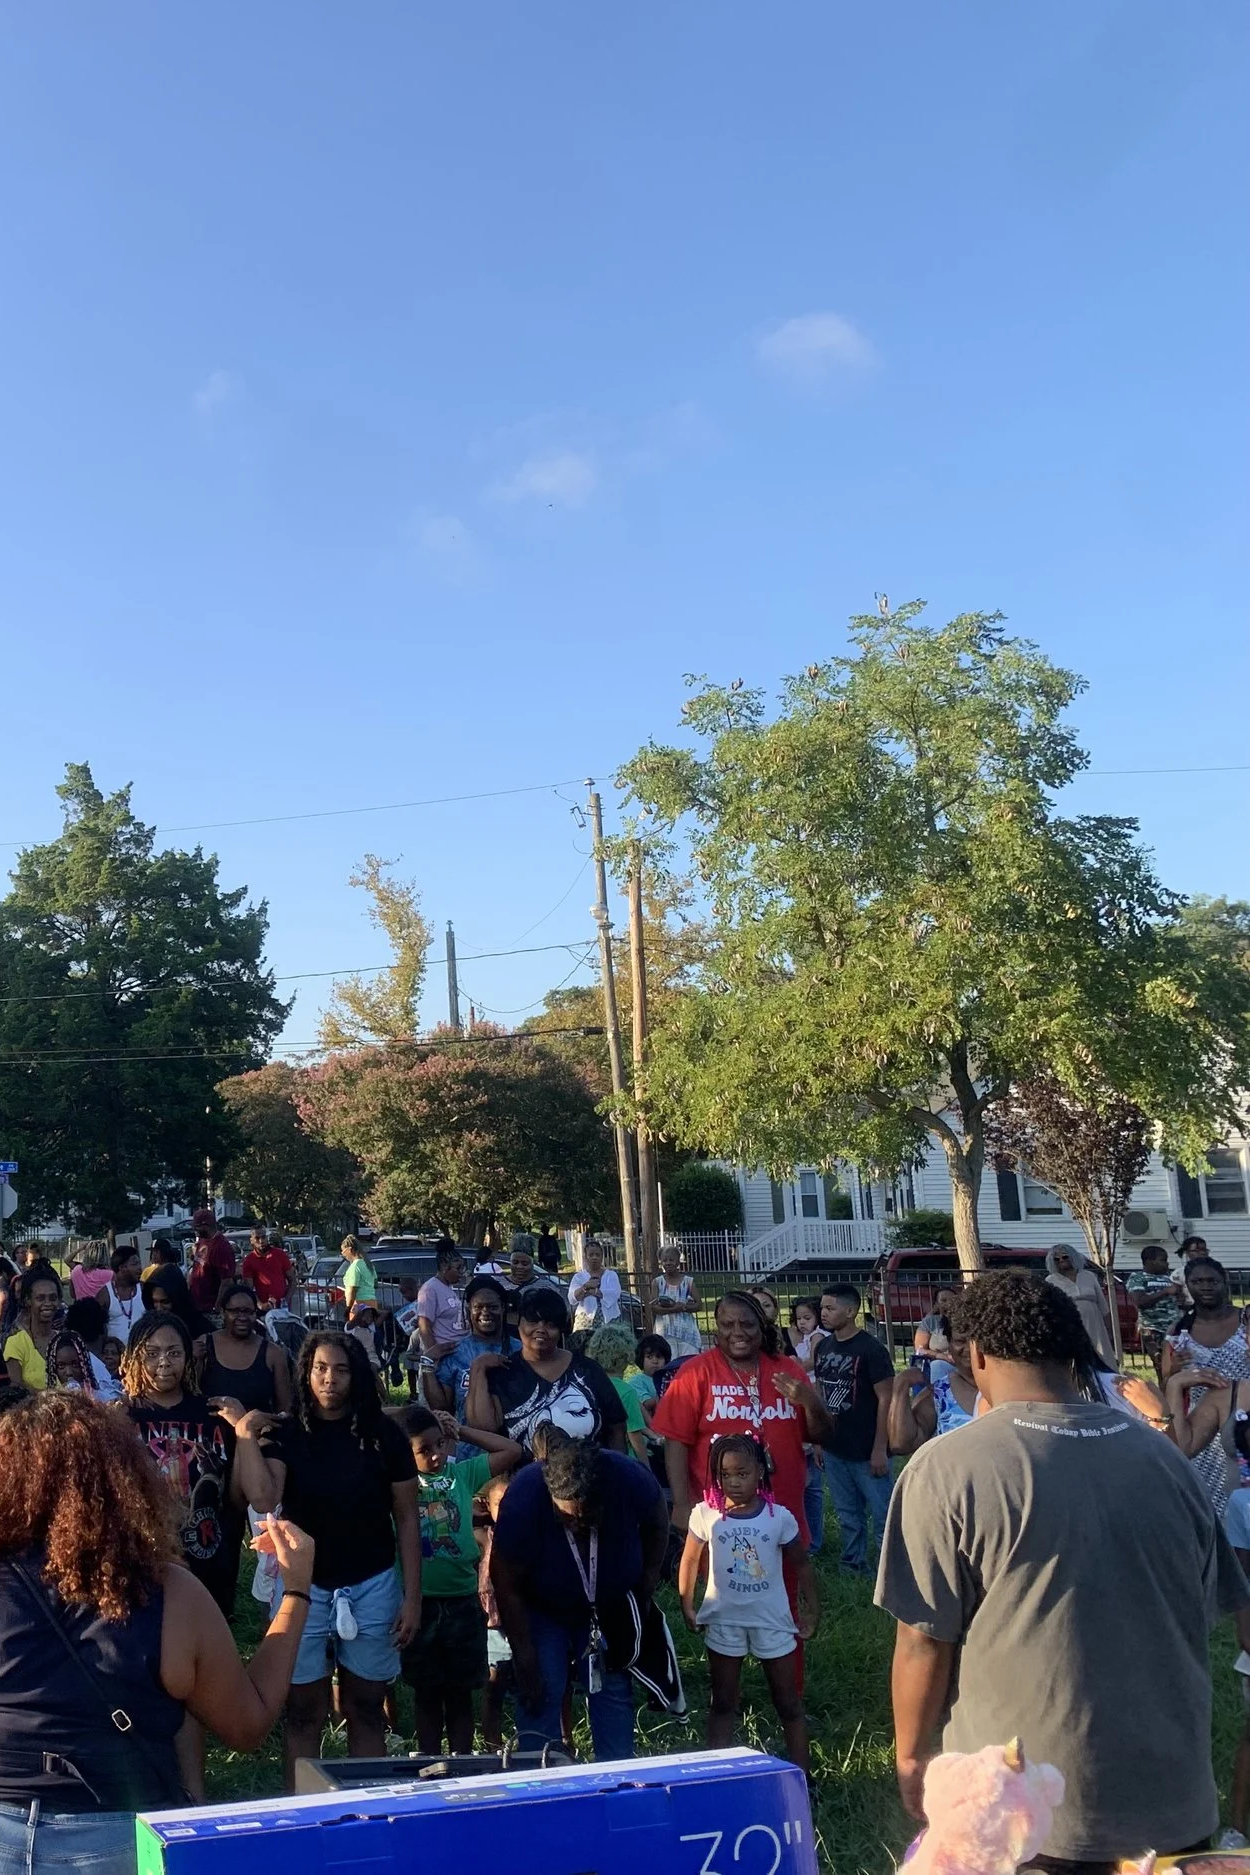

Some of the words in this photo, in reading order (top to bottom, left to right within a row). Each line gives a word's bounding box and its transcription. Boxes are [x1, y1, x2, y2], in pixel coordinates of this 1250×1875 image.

[711, 1385, 745, 1396] MADE
[706, 1396, 797, 1428] Norfolk
[1013, 1418, 1048, 1431] Revival
[1050, 1425, 1078, 1438] Today
[1080, 1428, 1101, 1438] Bible
[718, 1526, 760, 1544] BLUEY
[760, 1533, 770, 1542] &
[728, 1579, 769, 1593] BINGO
